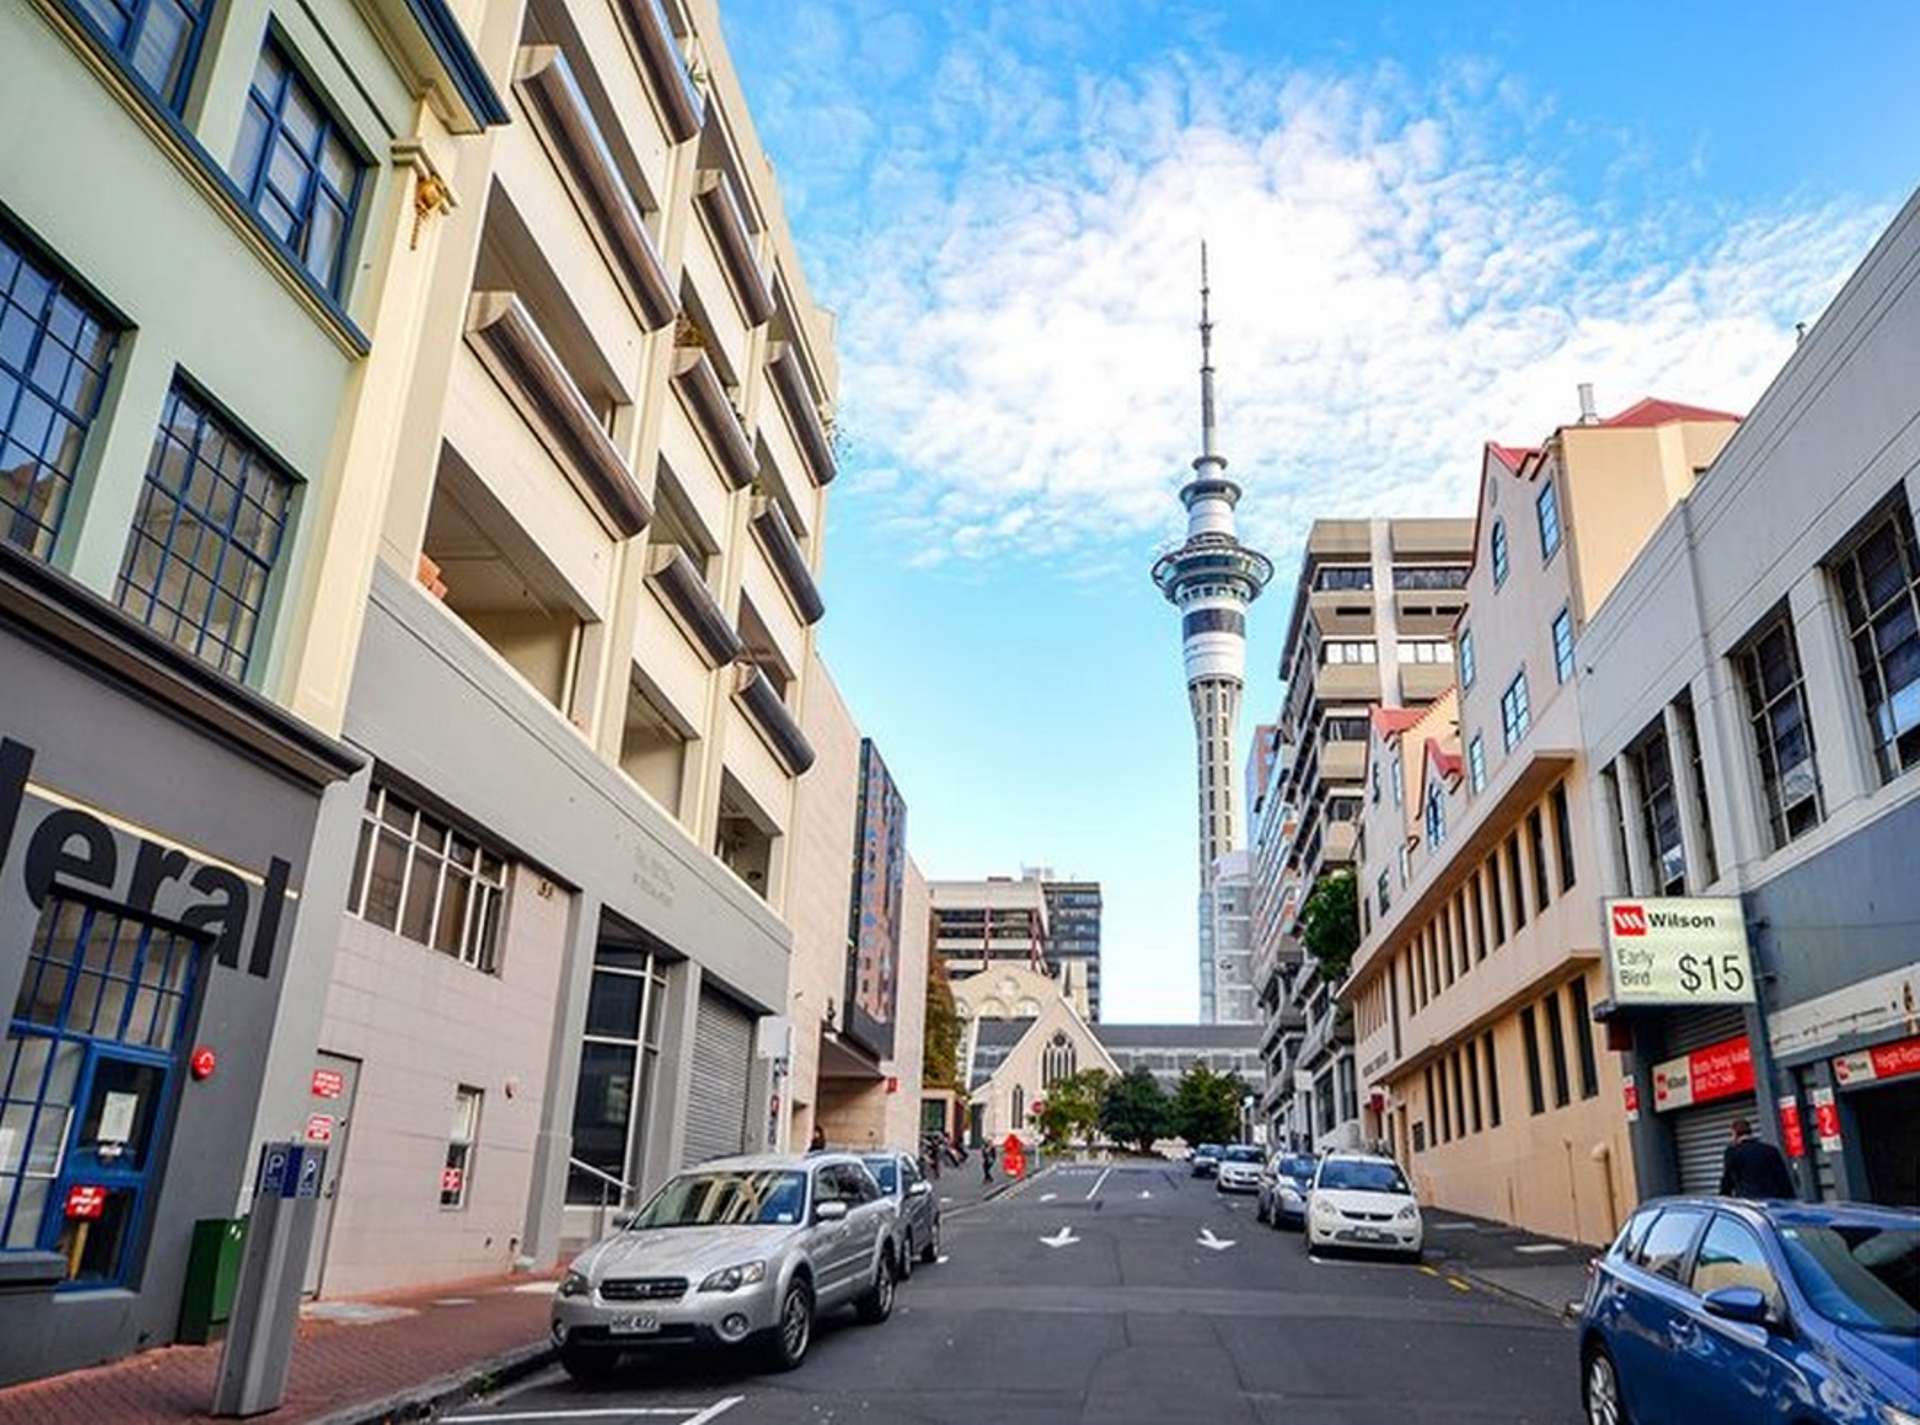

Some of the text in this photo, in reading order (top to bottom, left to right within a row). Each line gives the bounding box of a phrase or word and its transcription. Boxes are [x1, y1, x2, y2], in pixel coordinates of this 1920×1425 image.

[1648, 912, 1716, 928] Wilson
[1617, 948, 1655, 968] Early
[1619, 969, 1650, 986] Bird
[1678, 953, 1744, 993] $15
